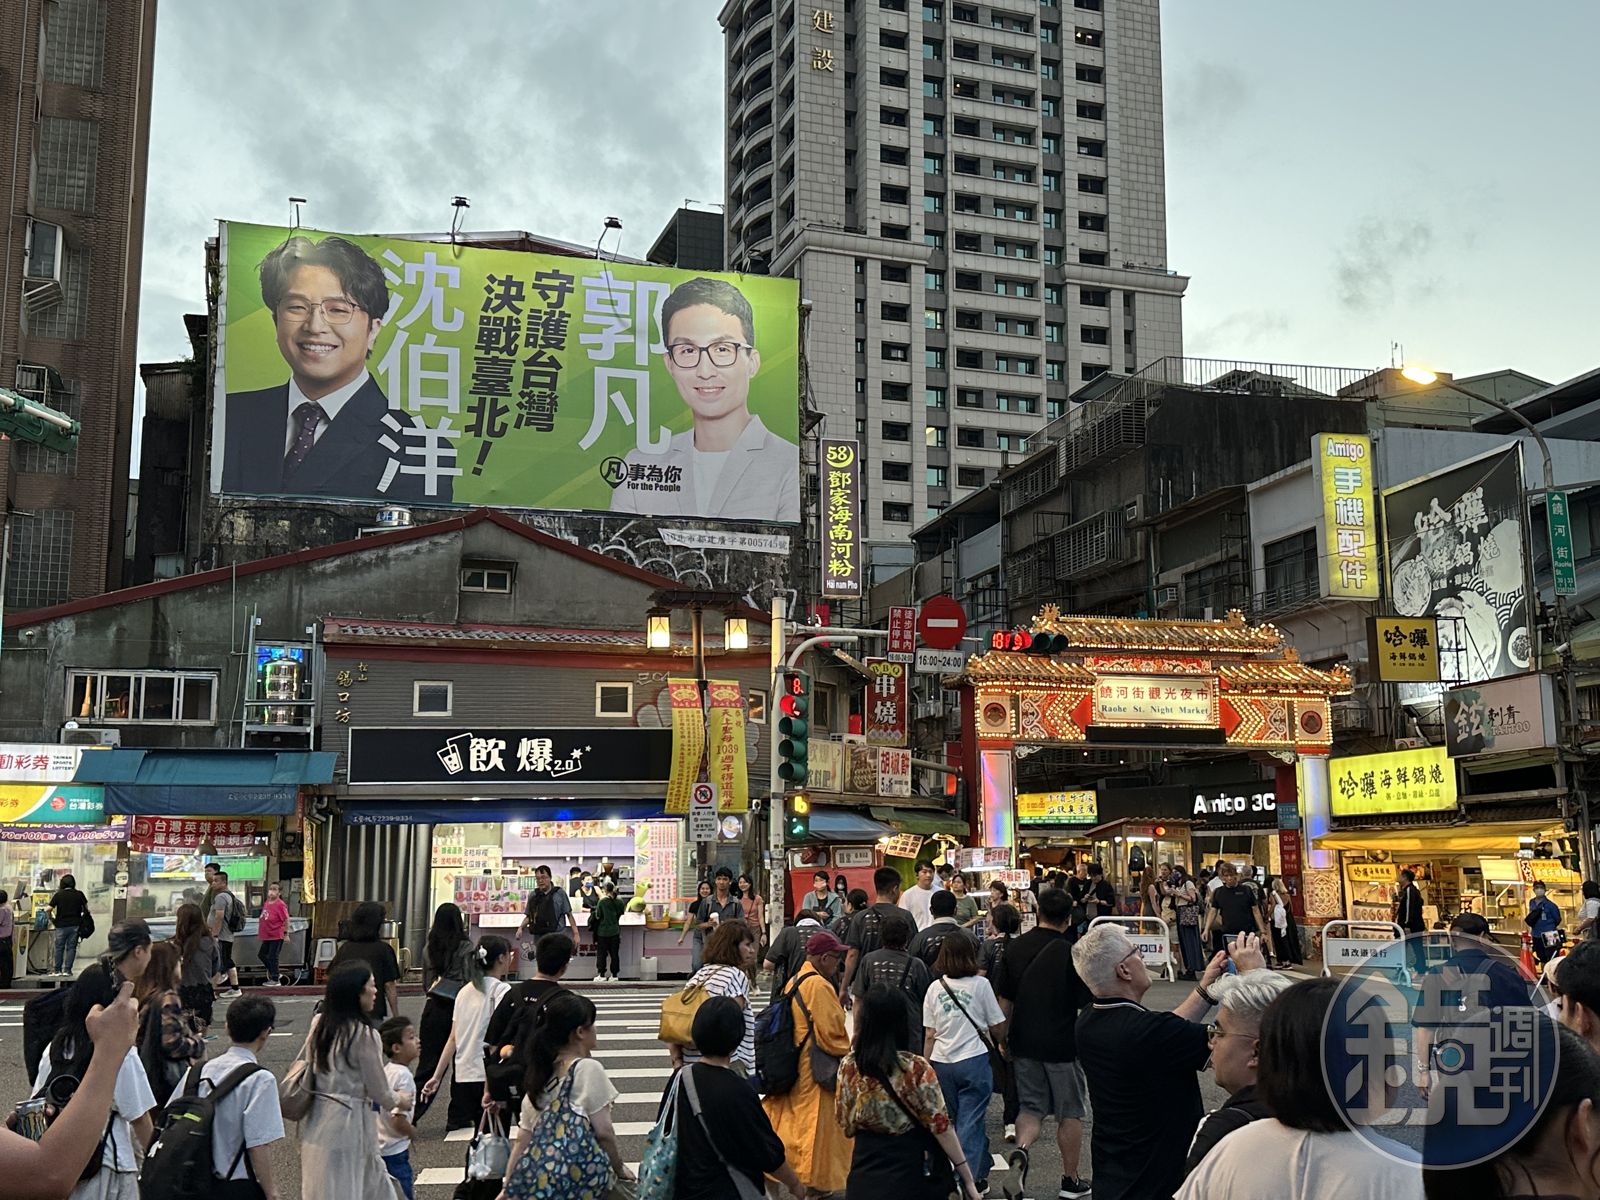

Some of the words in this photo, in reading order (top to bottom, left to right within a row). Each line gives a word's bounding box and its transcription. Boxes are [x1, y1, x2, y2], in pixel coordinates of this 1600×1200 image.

[812, 9, 835, 72] 建設
[513, 269, 575, 433] 守護台灣
[578, 270, 672, 455] 郭凡
[376, 248, 465, 497] 沈伯洋
[464, 273, 526, 477] 決戰臺北!
[826, 446, 848, 461] 58
[1326, 438, 1364, 462] Amigo
[601, 457, 682, 484] 凡事為你
[627, 481, 639, 490] For
[640, 482, 653, 491] the
[654, 483, 681, 492] People
[827, 470, 855, 577] 鄧家海南河粉
[1334, 466, 1367, 589] 手機配件
[1552, 502, 1568, 559] 饒河街
[891, 609, 901, 649] 禁止停車
[904, 610, 913, 650] 徒步區內
[872, 663, 900, 676] BBQ
[918, 654, 962, 668] 16:00~24:00
[335, 670, 353, 723] 錫口坊
[874, 674, 897, 724] 串燒
[1100, 686, 1209, 701] 饒河街觀光夜市
[1101, 704, 1127, 713] Raohe
[1133, 705, 1145, 713] St.
[1151, 705, 1173, 715] Night
[1179, 706, 1208, 715] Market
[1488, 705, 1520, 726] 刺青
[1491, 720, 1531, 736] TATTOO
[469, 737, 554, 772] 飲爆
[553, 759, 574, 771] 2.0
[1193, 793, 1246, 816] Amigo
[1252, 793, 1276, 811] 3C
